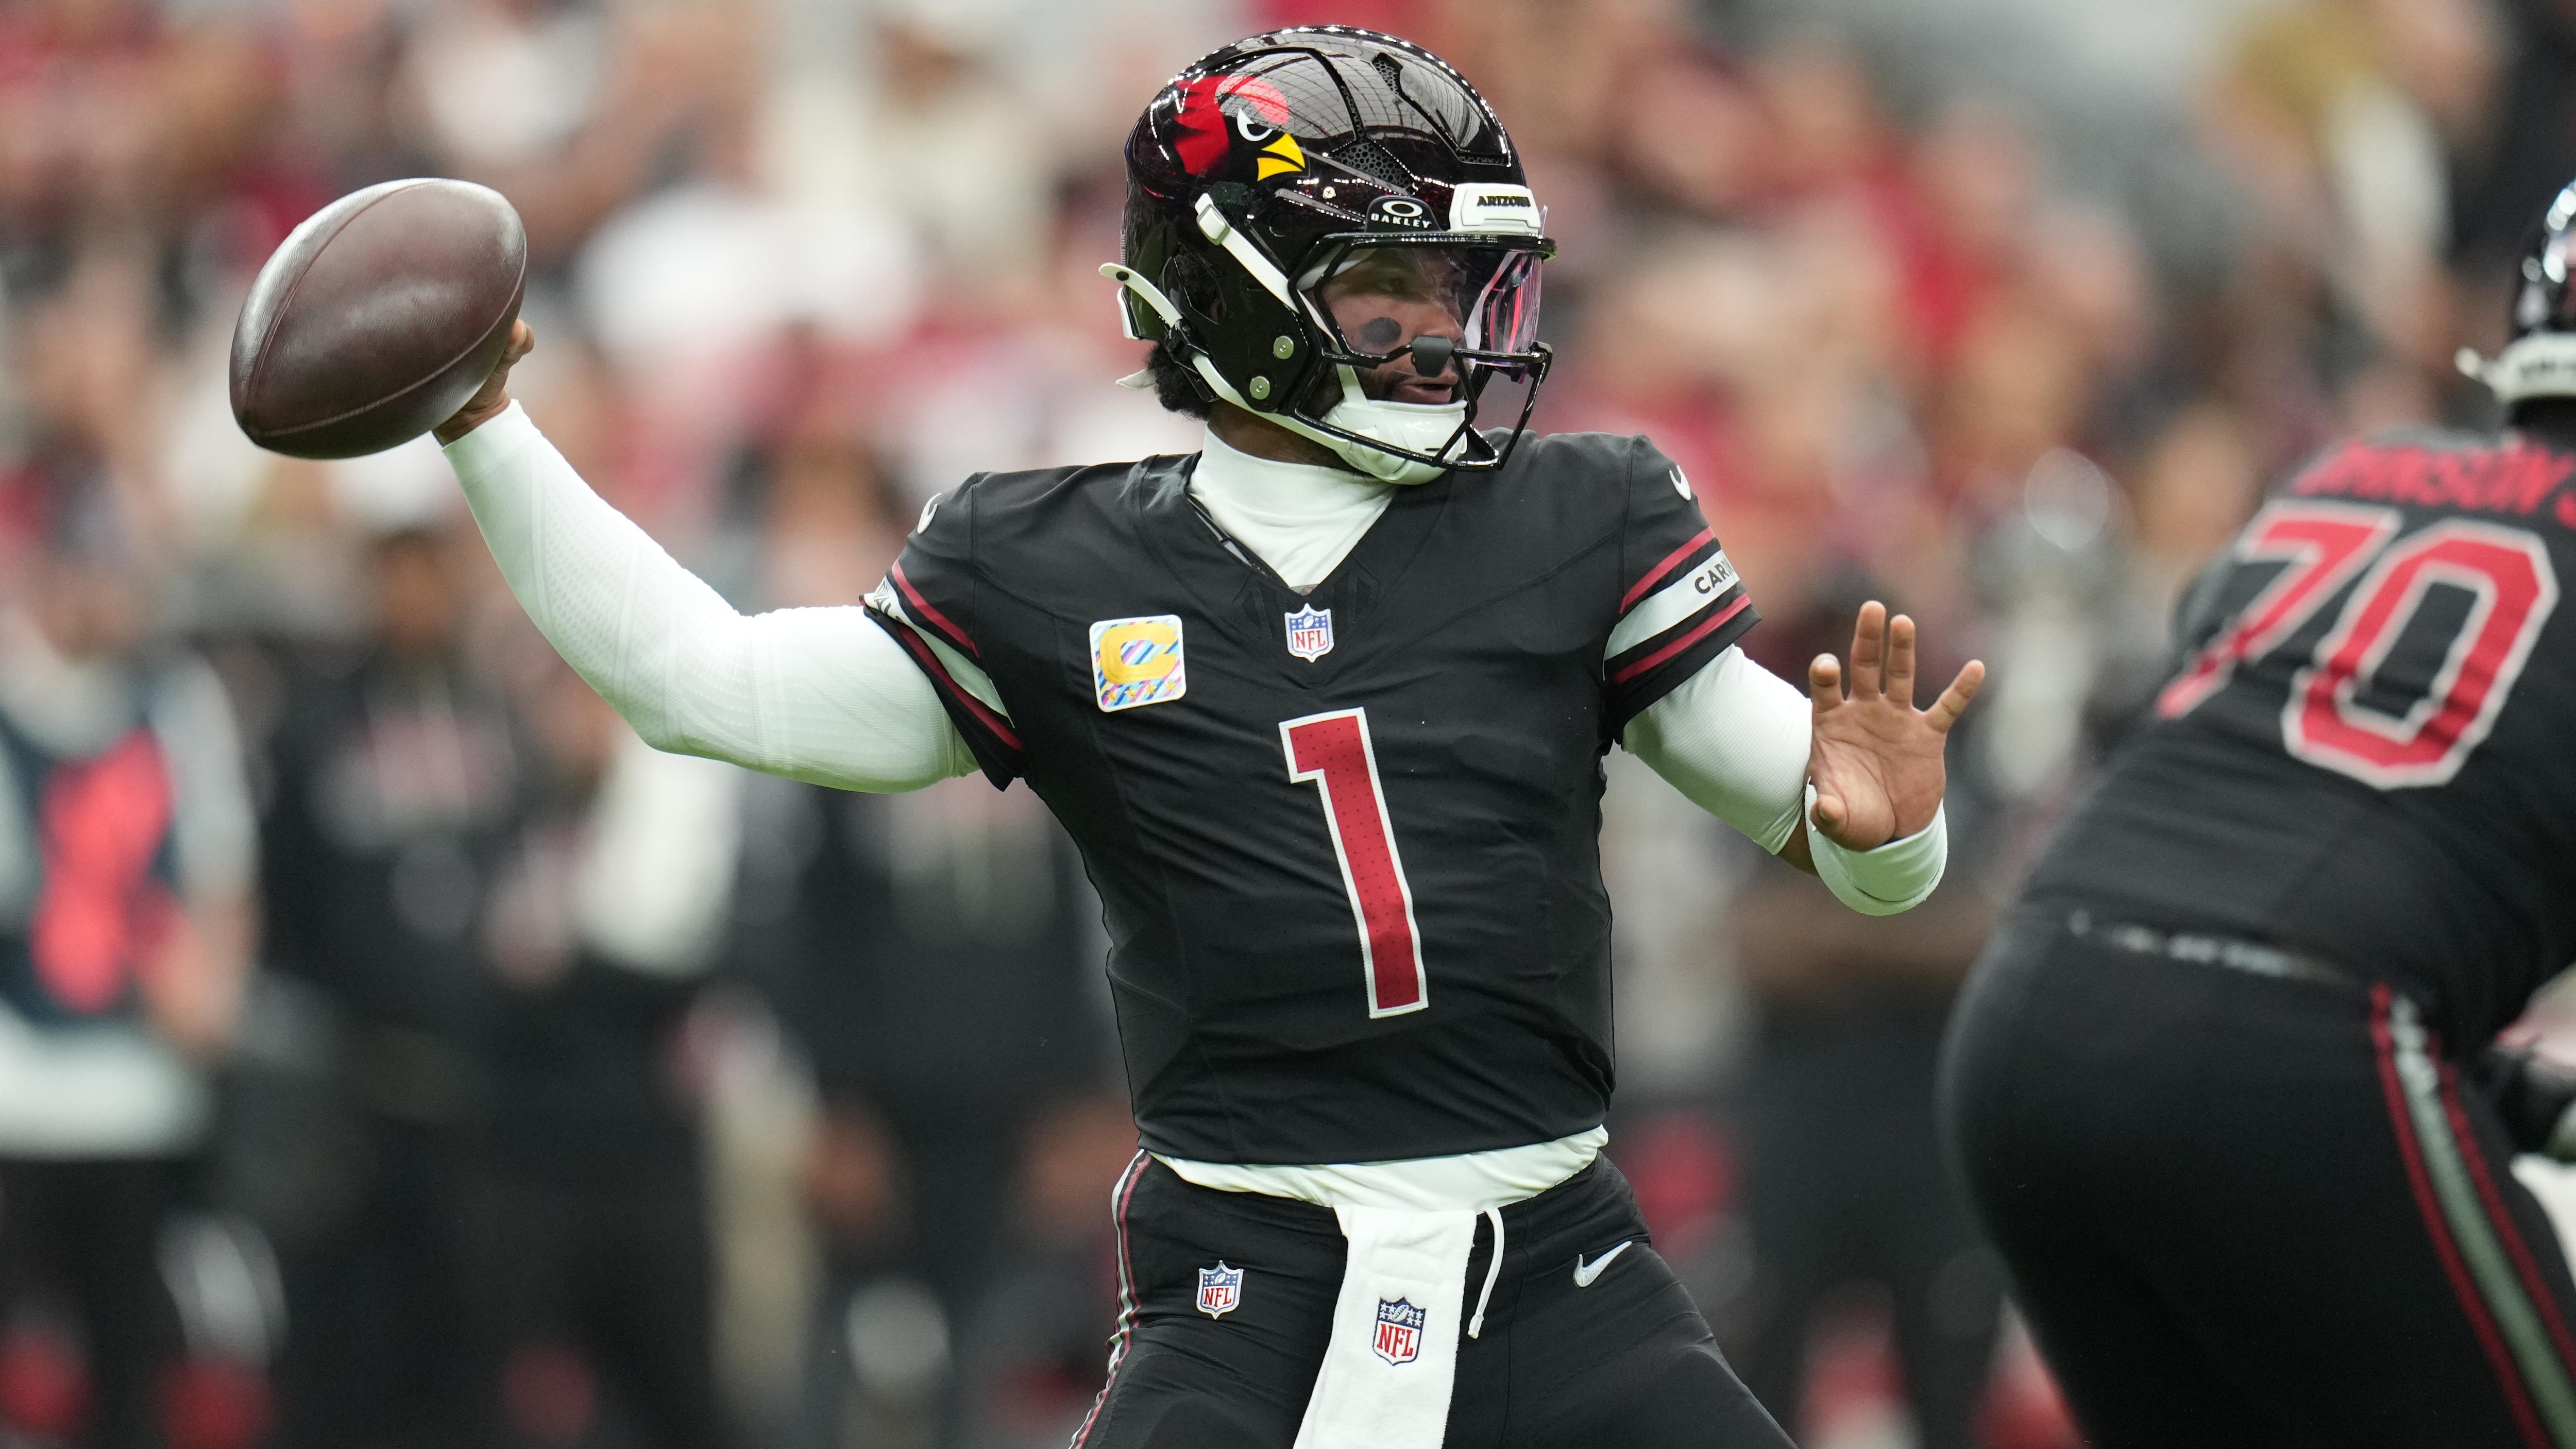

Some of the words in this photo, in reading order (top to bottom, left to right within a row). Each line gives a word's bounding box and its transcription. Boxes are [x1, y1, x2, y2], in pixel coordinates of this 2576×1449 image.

[1370, 213, 1431, 228] OAKLEY
[1099, 622, 1177, 685] C
[1294, 630, 1326, 651] NFL
[2155, 498, 2561, 790] 70
[1278, 706, 1429, 1019] 1
[1203, 1287, 1232, 1307] NFL
[1377, 1323, 1414, 1358] NFL
